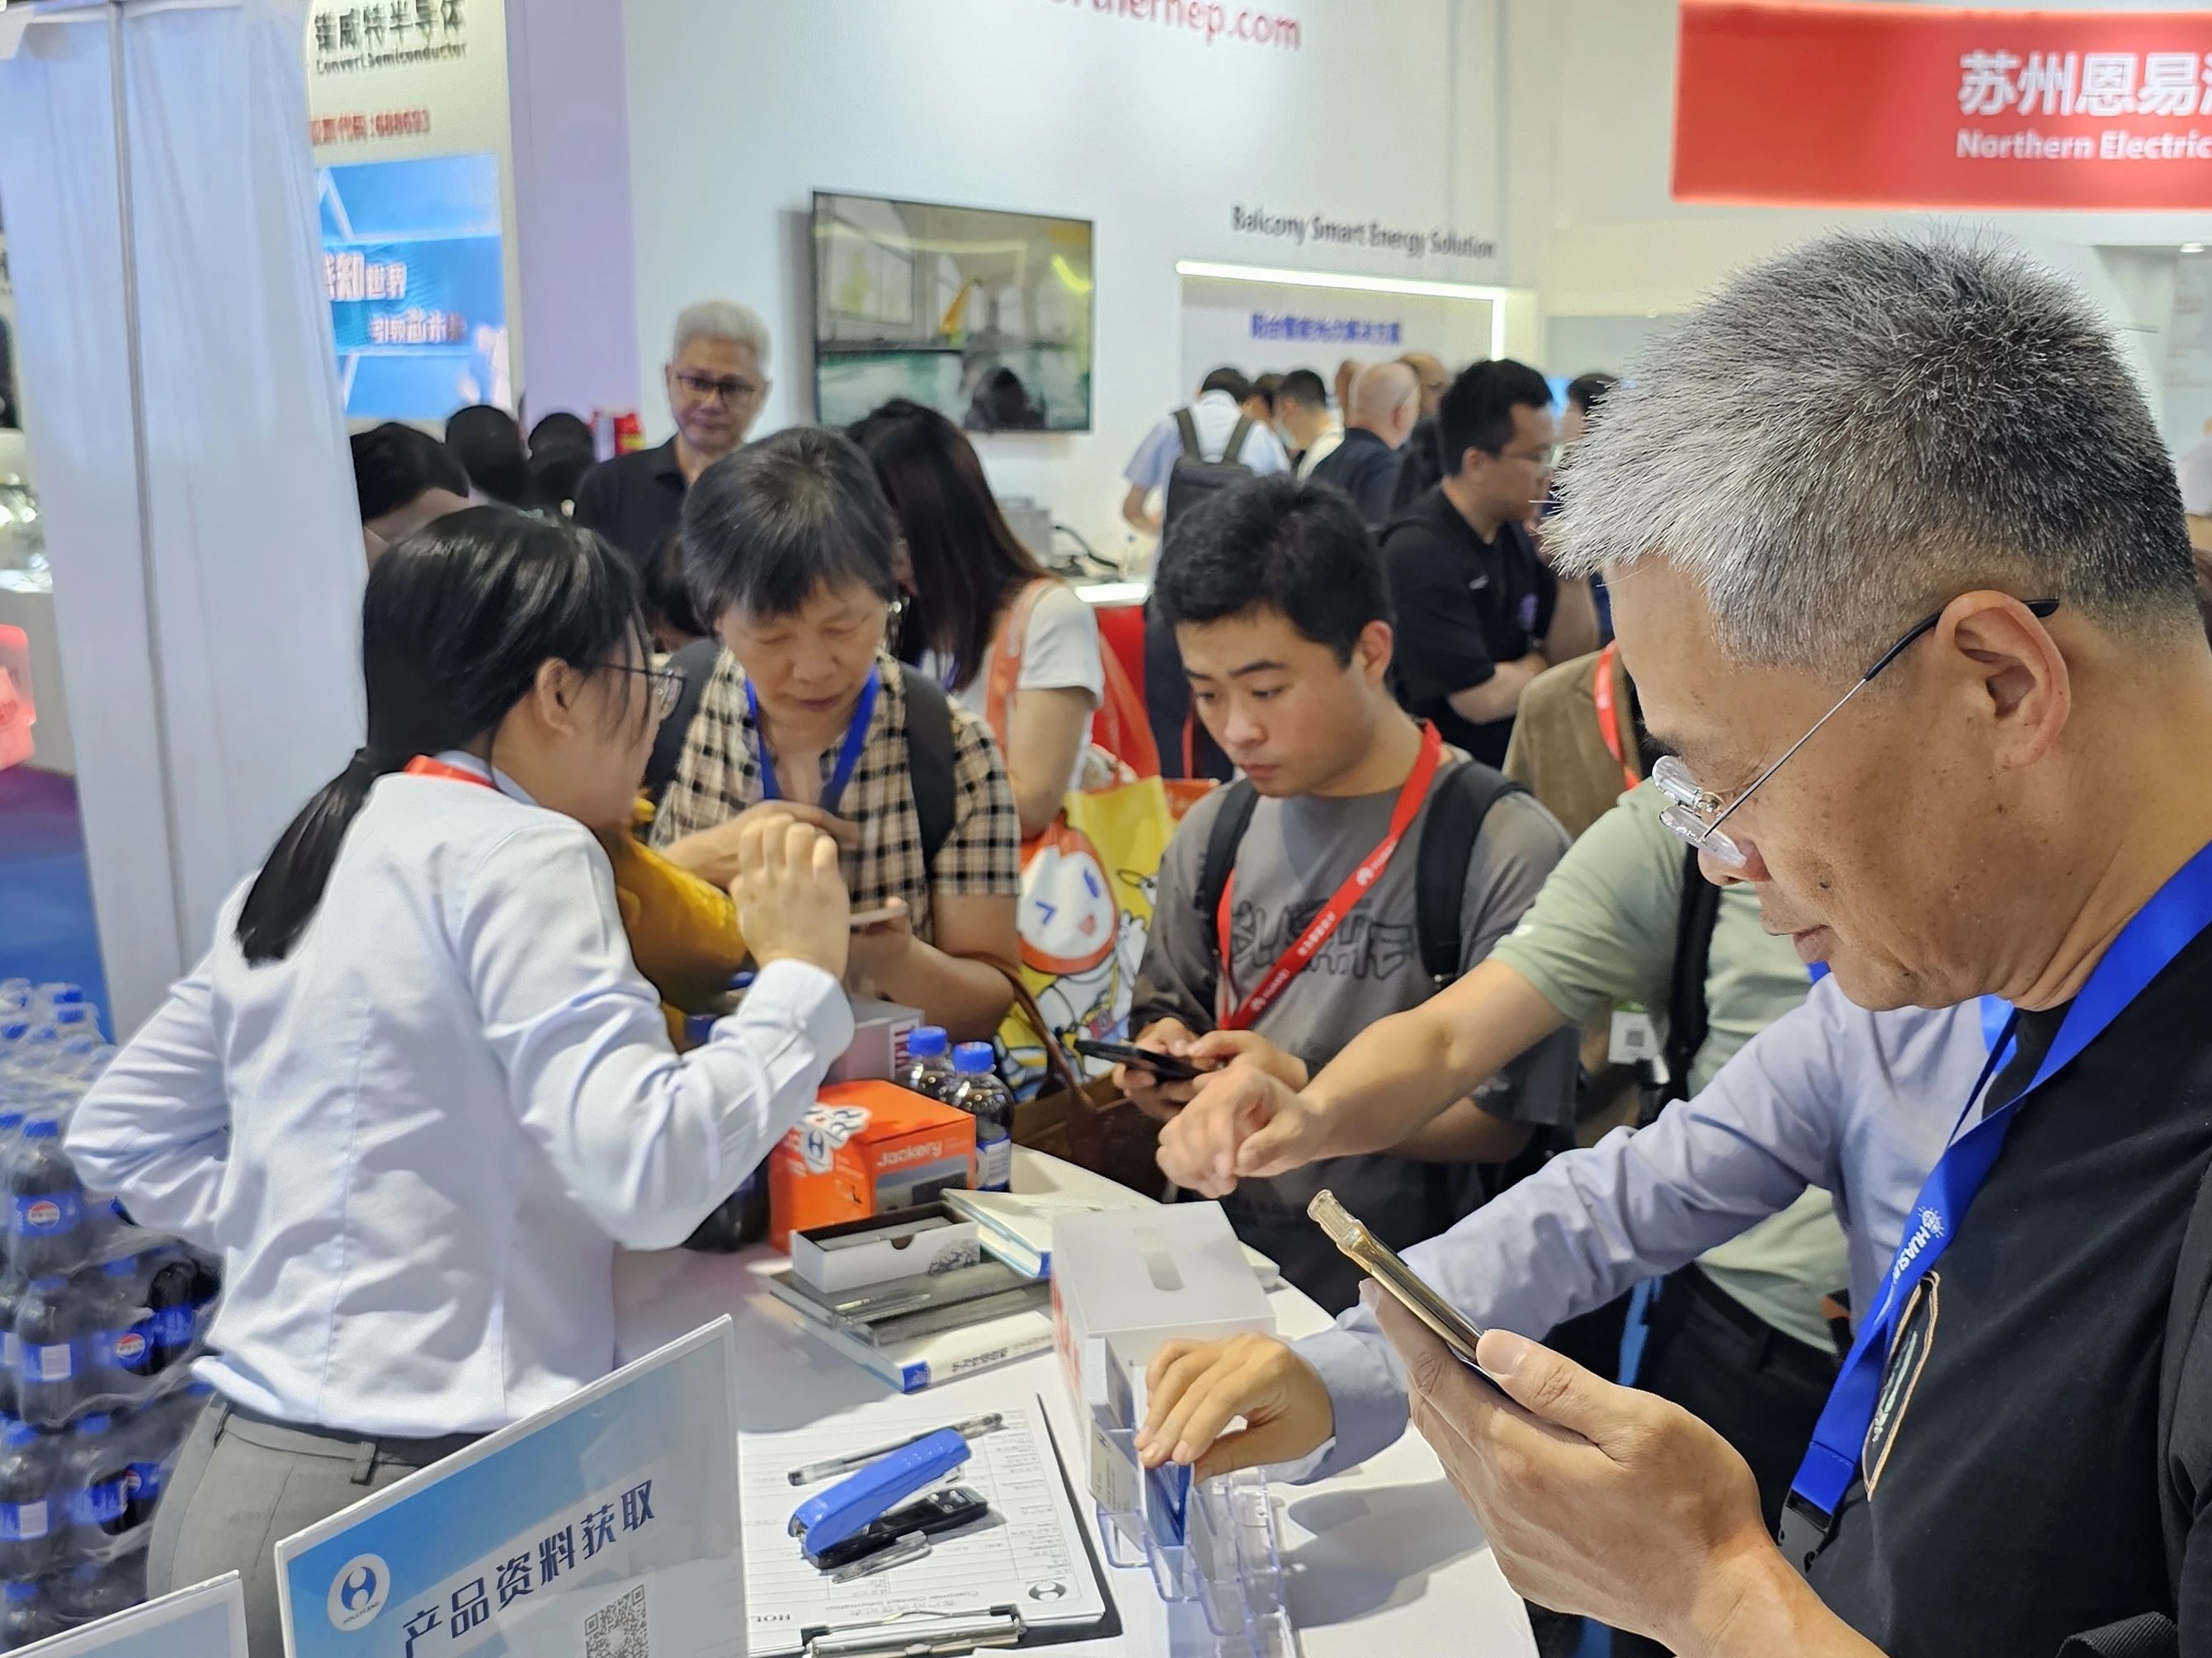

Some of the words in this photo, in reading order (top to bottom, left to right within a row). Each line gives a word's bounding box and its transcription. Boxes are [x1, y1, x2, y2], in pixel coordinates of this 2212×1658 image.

[1956, 128, 2096, 158] Northern
[2099, 129, 2212, 159] Electric
[1233, 205, 1305, 245] Balcony
[1312, 215, 1365, 245] Smart
[1370, 222, 1426, 258] Energy
[1430, 230, 1496, 260] Solution
[876, 1140, 943, 1169] Jackery
[403, 1480, 656, 1658] 产品资料获取
